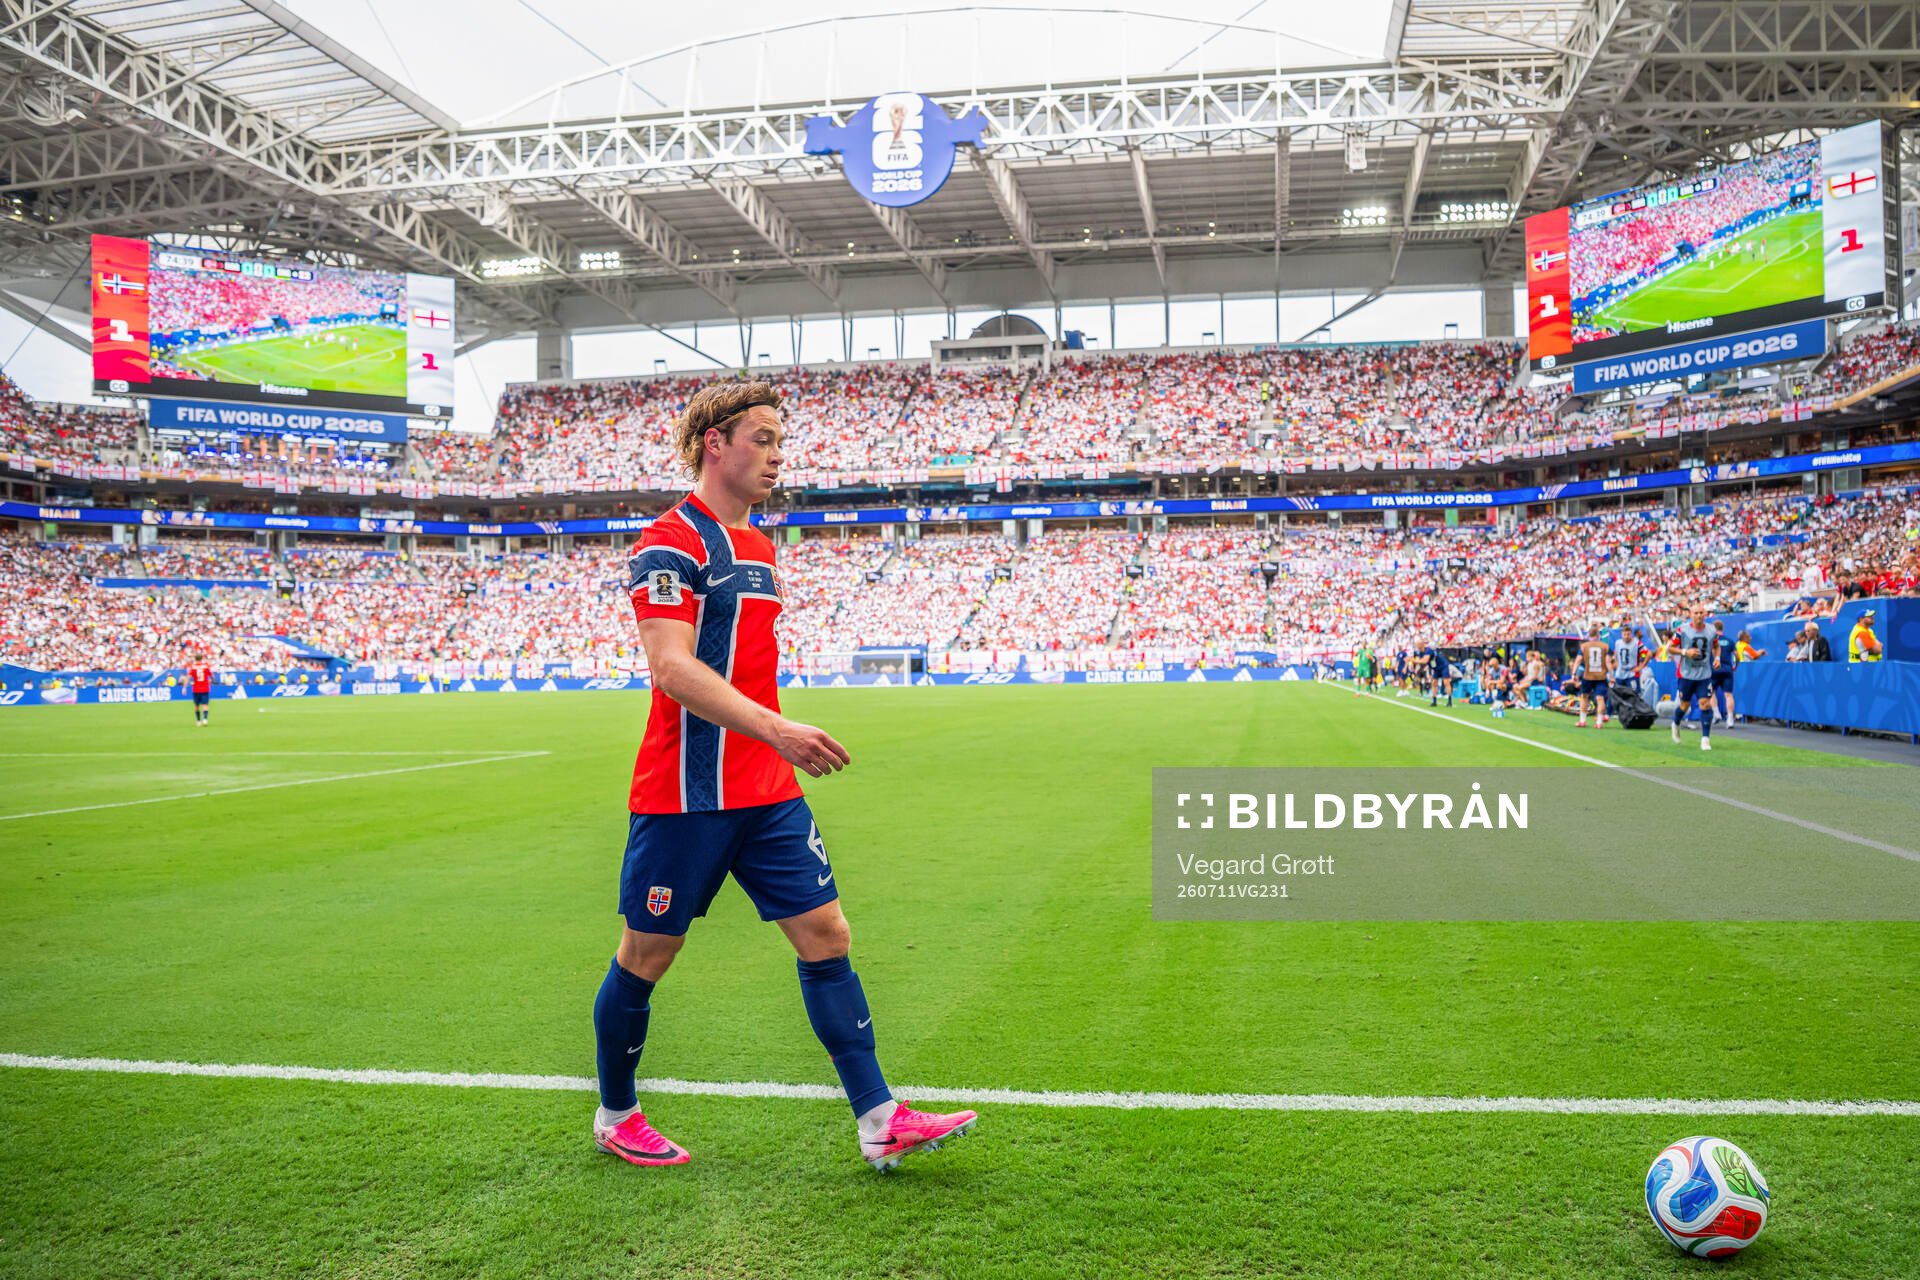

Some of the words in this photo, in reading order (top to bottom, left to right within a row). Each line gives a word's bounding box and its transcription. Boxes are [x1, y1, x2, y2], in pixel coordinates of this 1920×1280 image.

[888, 153, 909, 162] FIFA
[873, 171, 904, 180] WORLD
[905, 170, 923, 179] CUP
[872, 179, 923, 193] 2026
[1840, 229, 1863, 253] 1
[1539, 295, 1559, 318] 1
[110, 319, 134, 342] 1
[1666, 316, 1713, 333] Hisense
[421, 353, 439, 371] 1
[1594, 364, 1630, 383] FIFA
[1631, 354, 1692, 377] WORLD
[1694, 345, 1730, 367] CUP
[1732, 333, 1798, 360] 2026
[260, 380, 308, 396] Hisense
[177, 407, 217, 424] FIFA
[219, 409, 286, 428] WORLD
[287, 414, 323, 430] CUP
[324, 417, 385, 434] 2026
[1602, 477, 1638, 490] MIAMI
[1211, 500, 1248, 510] MIAMI
[1372, 496, 1395, 506] FIFA
[1395, 495, 1433, 505] WORLD
[1434, 495, 1455, 505] CUP
[1455, 493, 1493, 504] 2026
[39, 508, 80, 519] MIAMI
[607, 520, 628, 529] FIFA
[1086, 670, 1124, 682] CAUSE
[1125, 670, 1165, 682] CHAOS
[98, 688, 134, 702] CAUSE
[136, 687, 171, 702] CHAOS
